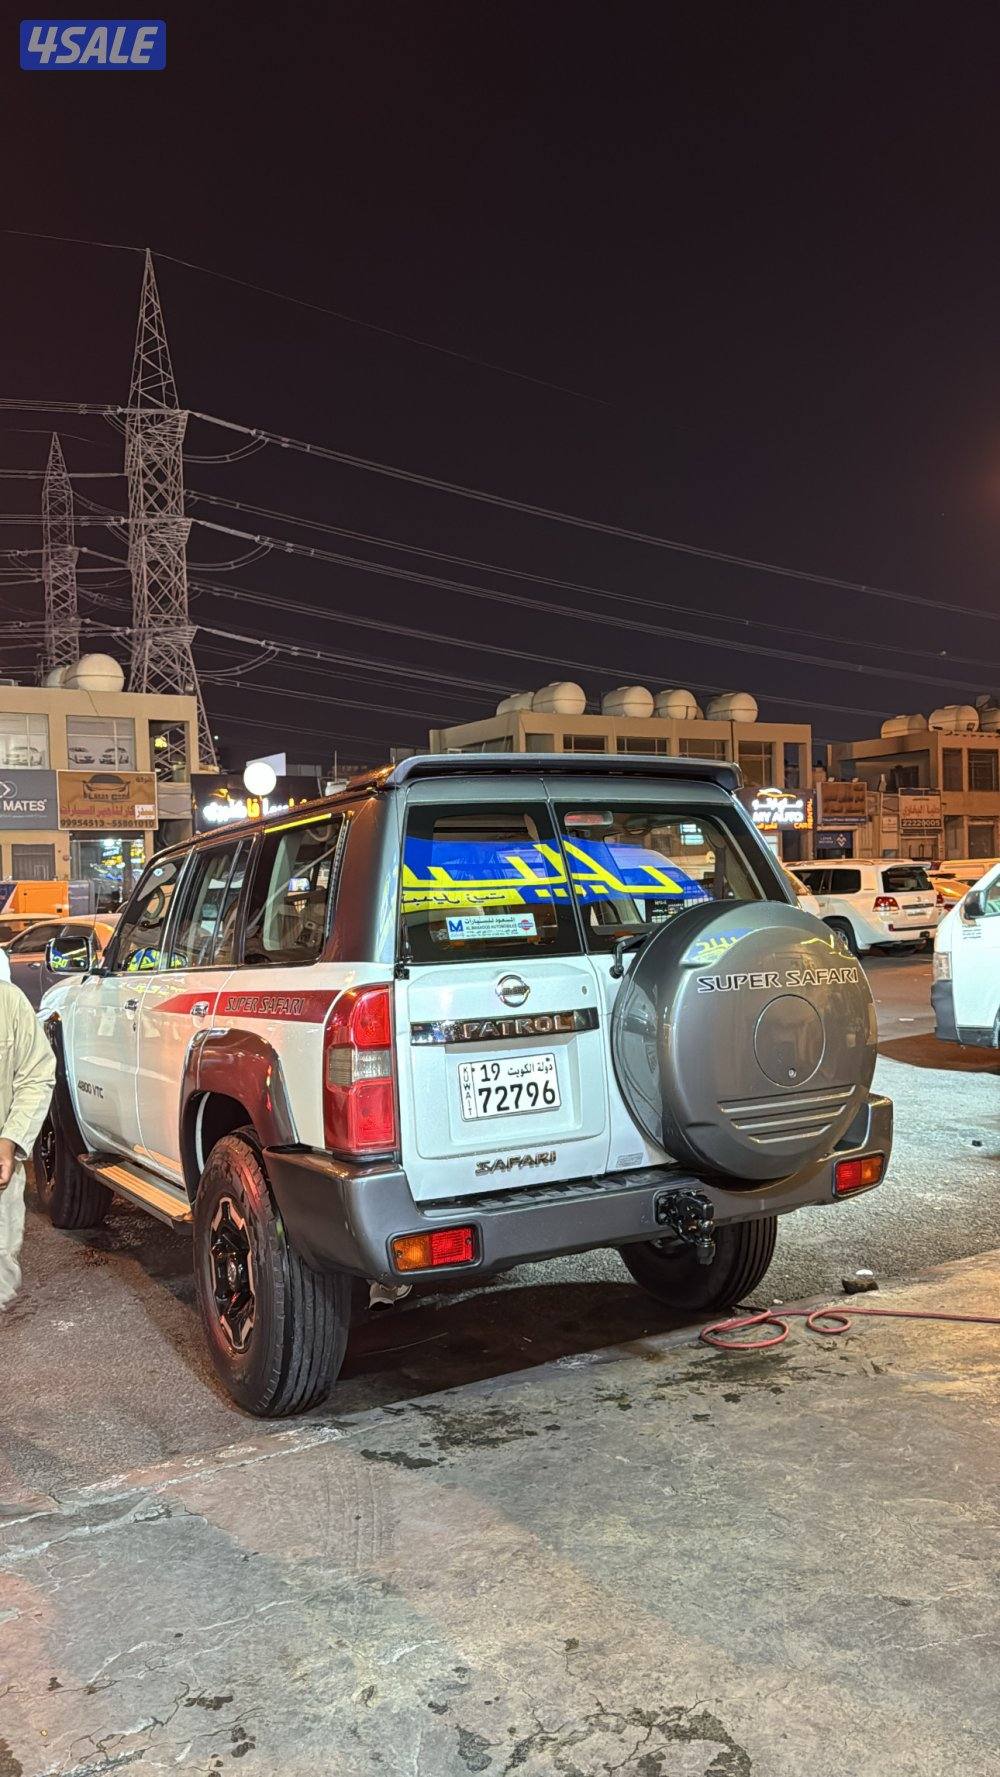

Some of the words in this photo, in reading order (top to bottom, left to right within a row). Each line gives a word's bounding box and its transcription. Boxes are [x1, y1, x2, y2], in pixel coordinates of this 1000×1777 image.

[3, 800, 46, 811] MATES
[697, 971, 782, 993] SUPER
[785, 967, 858, 987] SAFARI
[225, 996, 259, 1013] SUPER
[259, 996, 305, 1016] SAFARI
[462, 1013, 574, 1040] PATROL
[480, 1062, 500, 1083] 19
[507, 1064, 535, 1079] الكويت
[537, 1062, 553, 1075] دولة
[462, 1066, 473, 1116] KUWAIT
[478, 1080, 556, 1113] 72796
[474, 1150, 557, 1177] SAFARI
